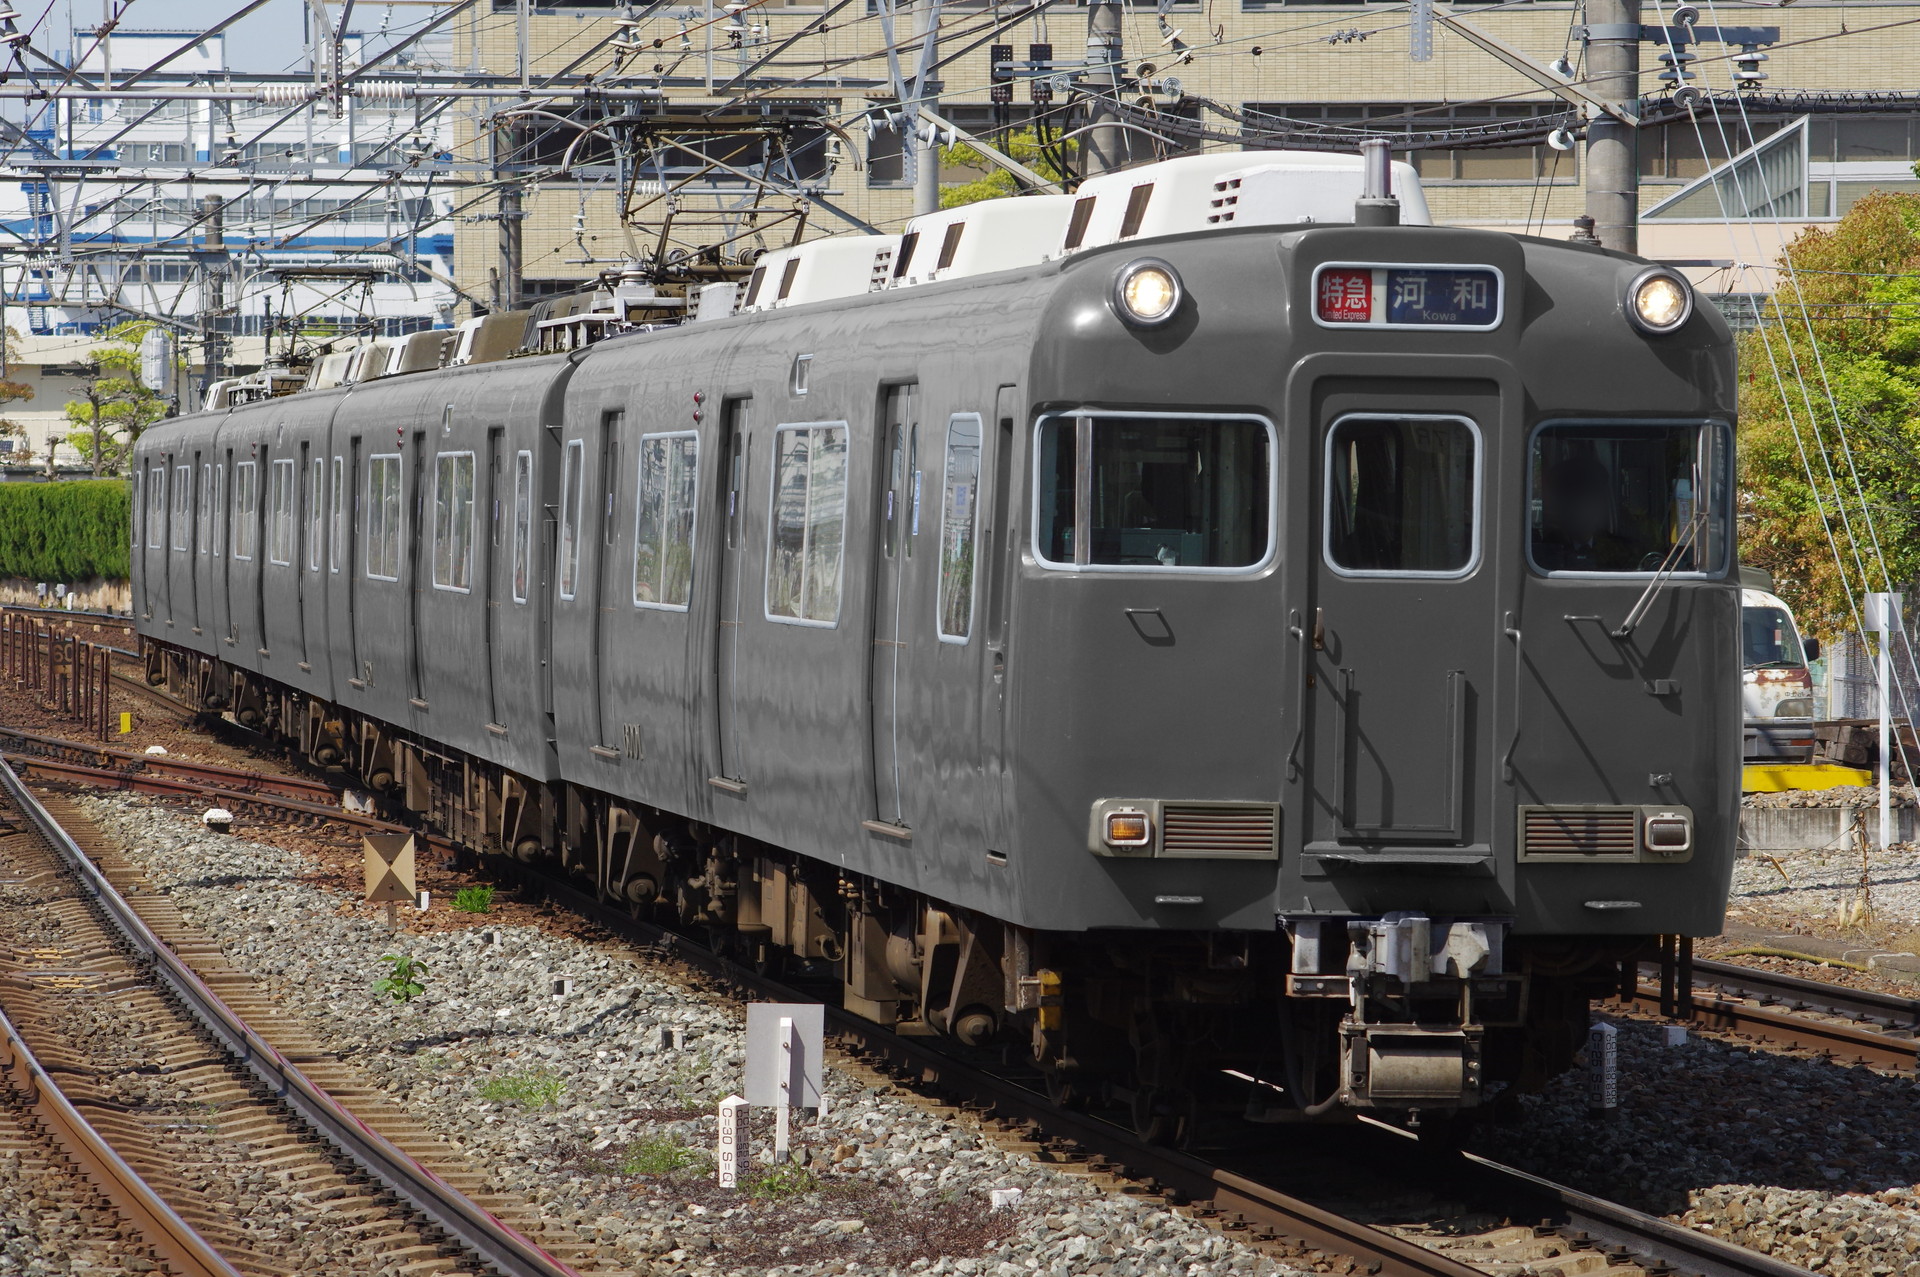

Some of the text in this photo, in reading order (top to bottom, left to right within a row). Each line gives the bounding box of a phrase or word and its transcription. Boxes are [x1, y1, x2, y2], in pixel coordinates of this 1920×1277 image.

[1322, 275, 1367, 309] 特急
[1321, 309, 1367, 321] Limited Express
[1422, 310, 1457, 321] Kowa
[722, 1107, 733, 1145] C=30
